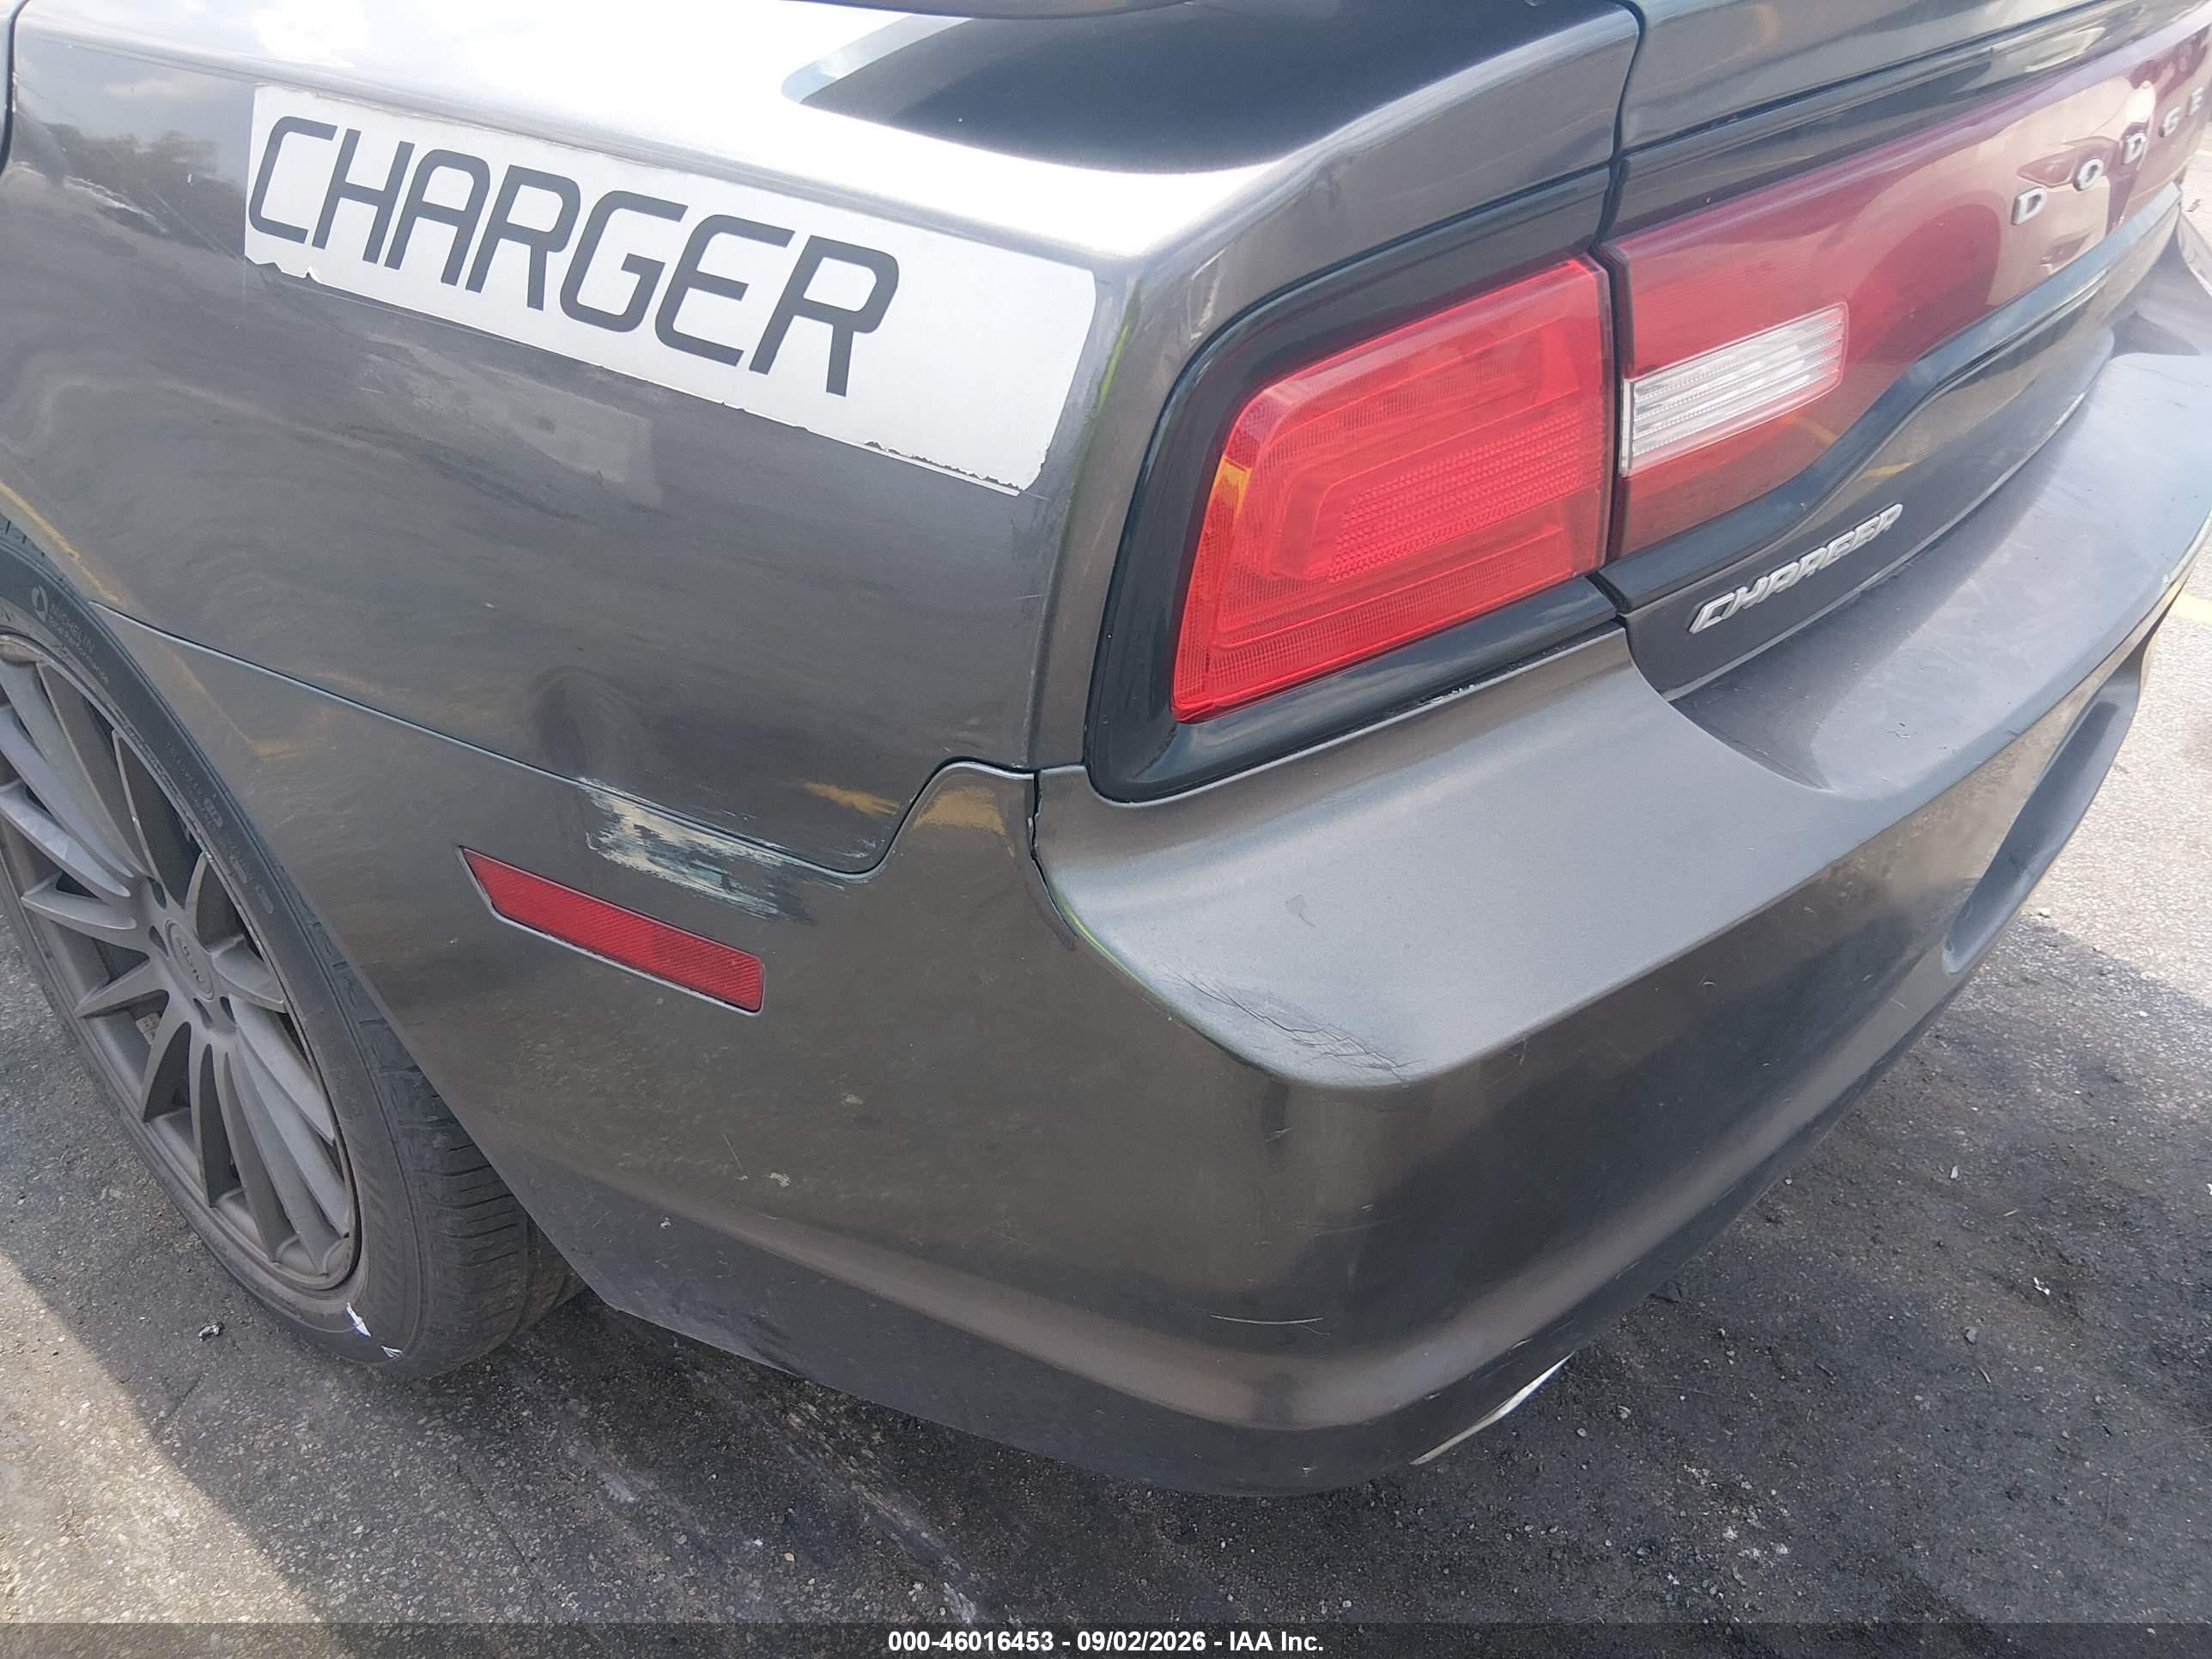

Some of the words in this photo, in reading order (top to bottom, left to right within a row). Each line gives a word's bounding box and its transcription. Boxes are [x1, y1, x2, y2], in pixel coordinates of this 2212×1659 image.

[2011, 86, 2204, 225] DODGE
[248, 114, 900, 398] CHARGER
[1688, 502, 1904, 635] CHARGER
